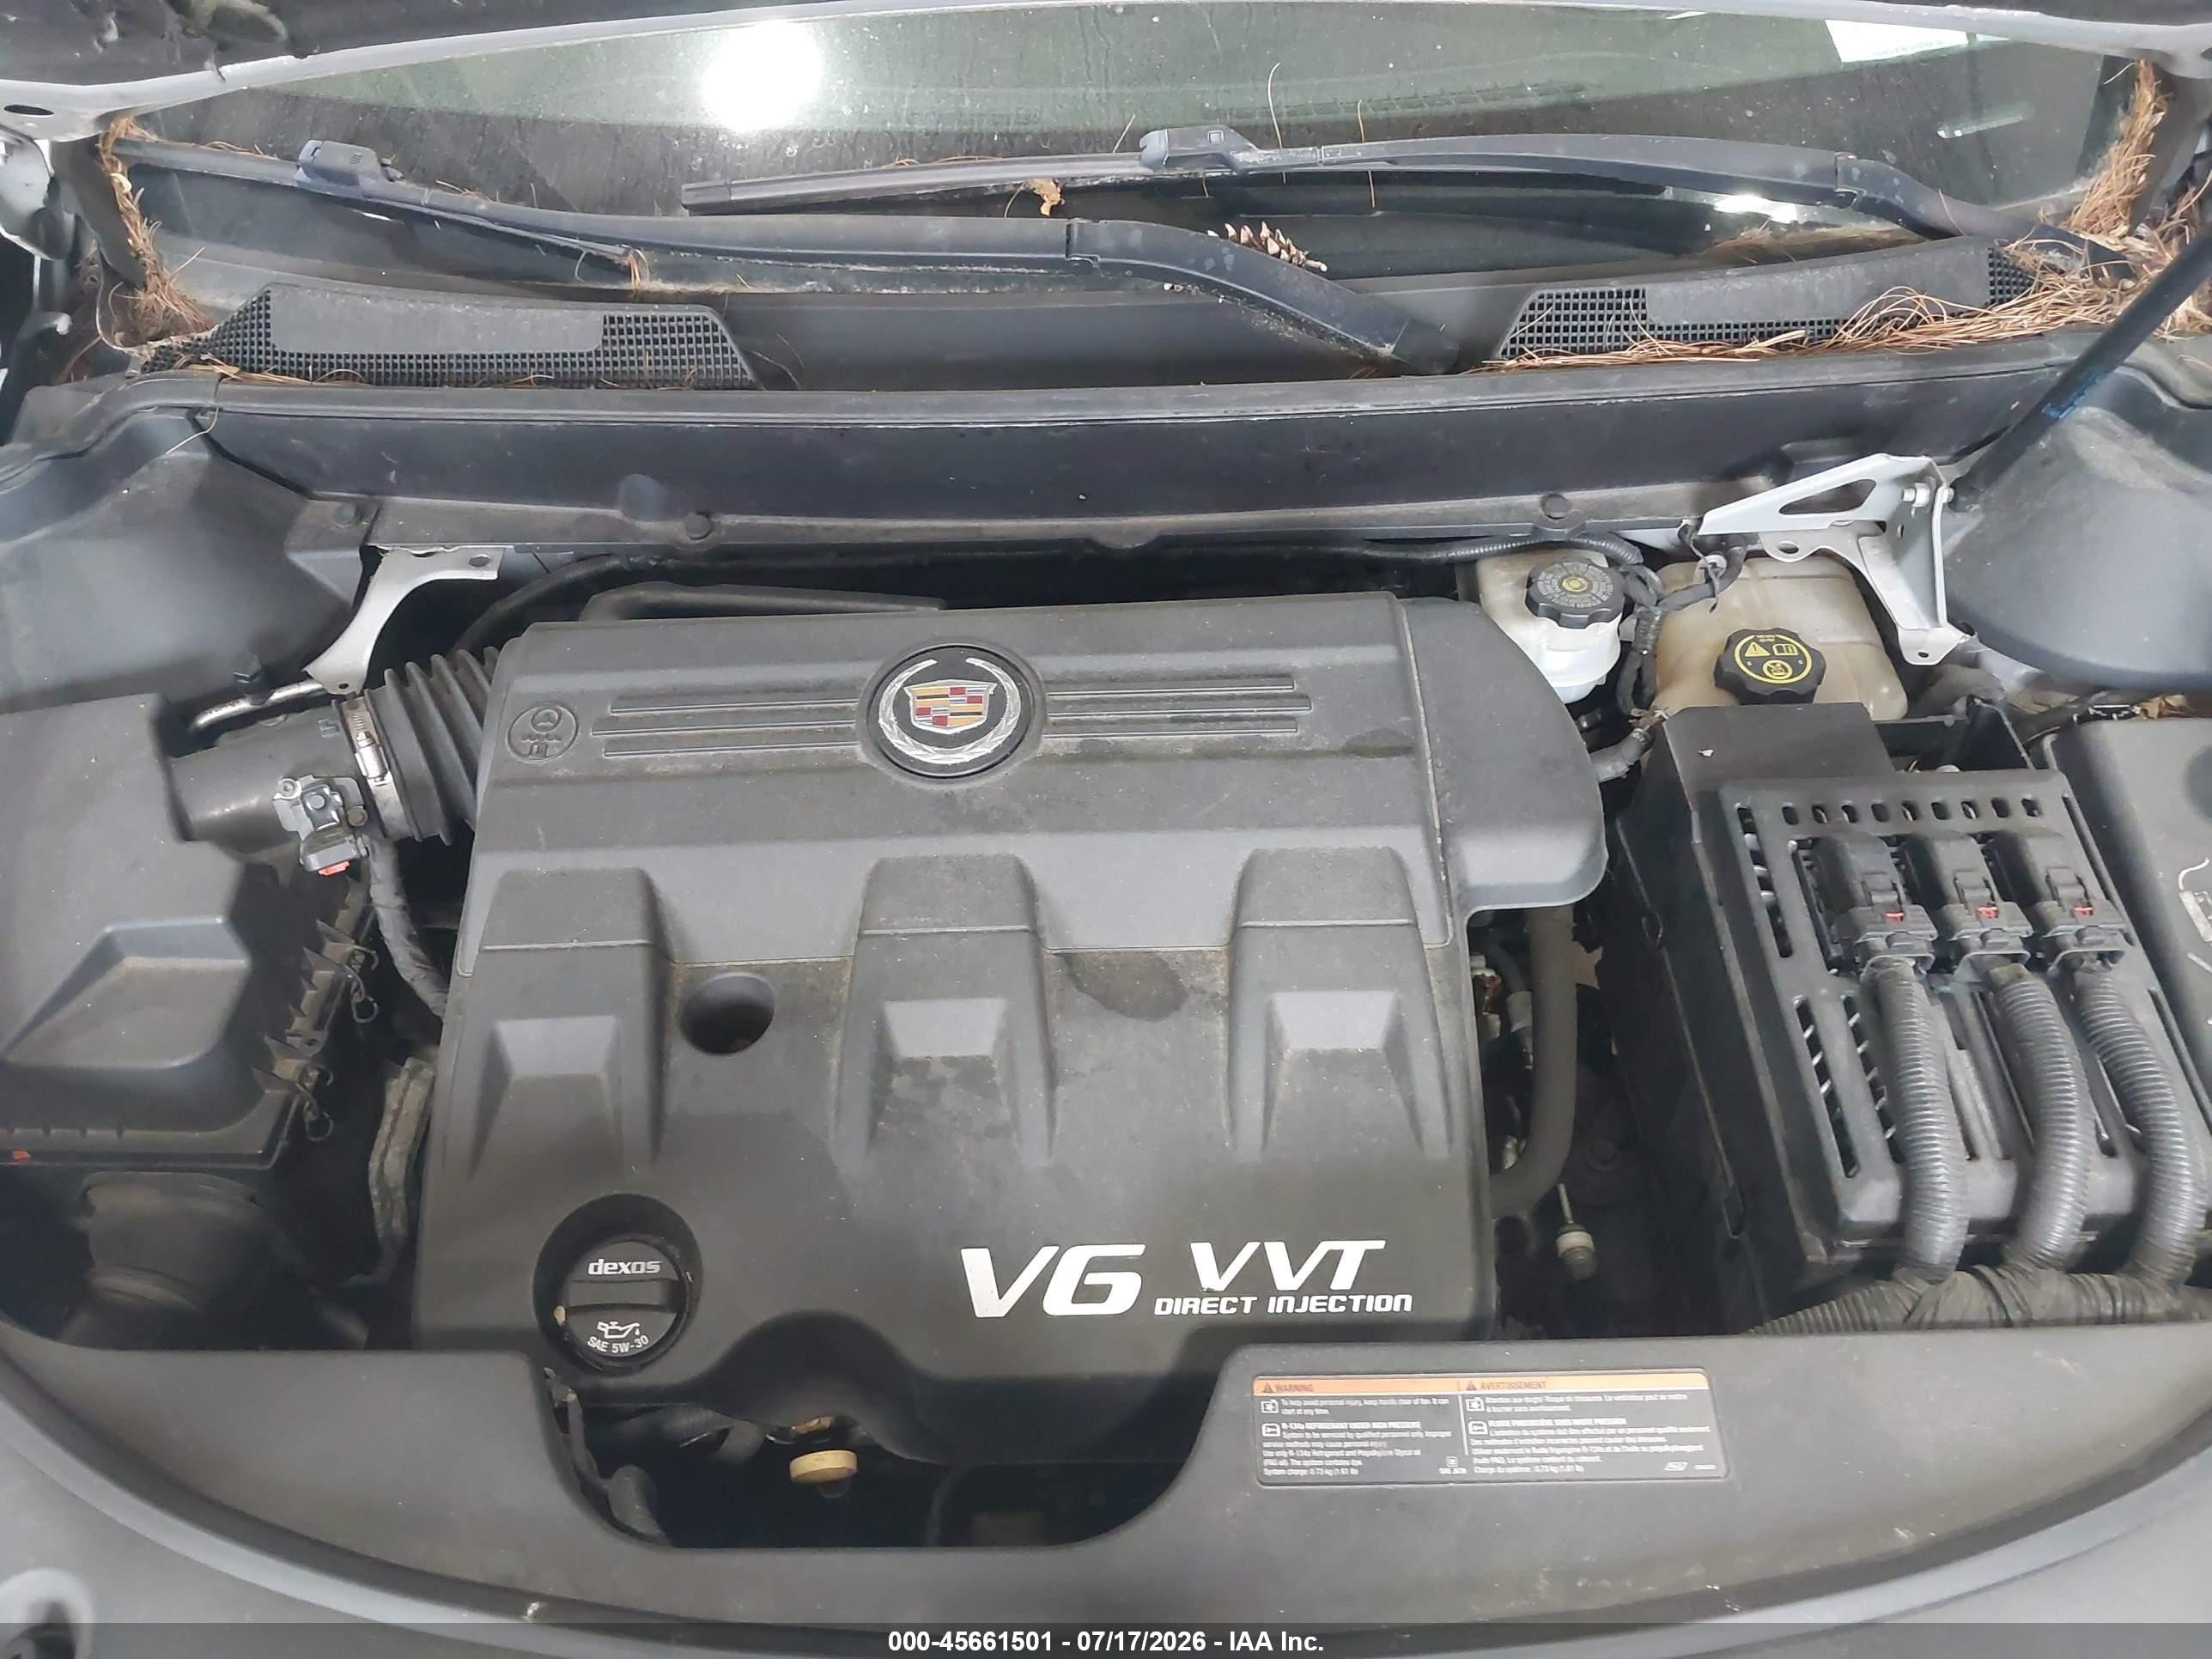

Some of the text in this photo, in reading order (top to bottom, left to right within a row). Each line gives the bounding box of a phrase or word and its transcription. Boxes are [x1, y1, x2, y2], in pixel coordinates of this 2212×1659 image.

[588, 1258, 662, 1275] dexos
[961, 1240, 1386, 1317] V6 VVT
[1154, 1294, 1413, 1316] DIRECT INJECTION
[587, 1335, 649, 1354] SAE 5W-30
[1275, 1383, 1313, 1393] WARNING
[1481, 1381, 1547, 1389] AVERTISSEMENT
